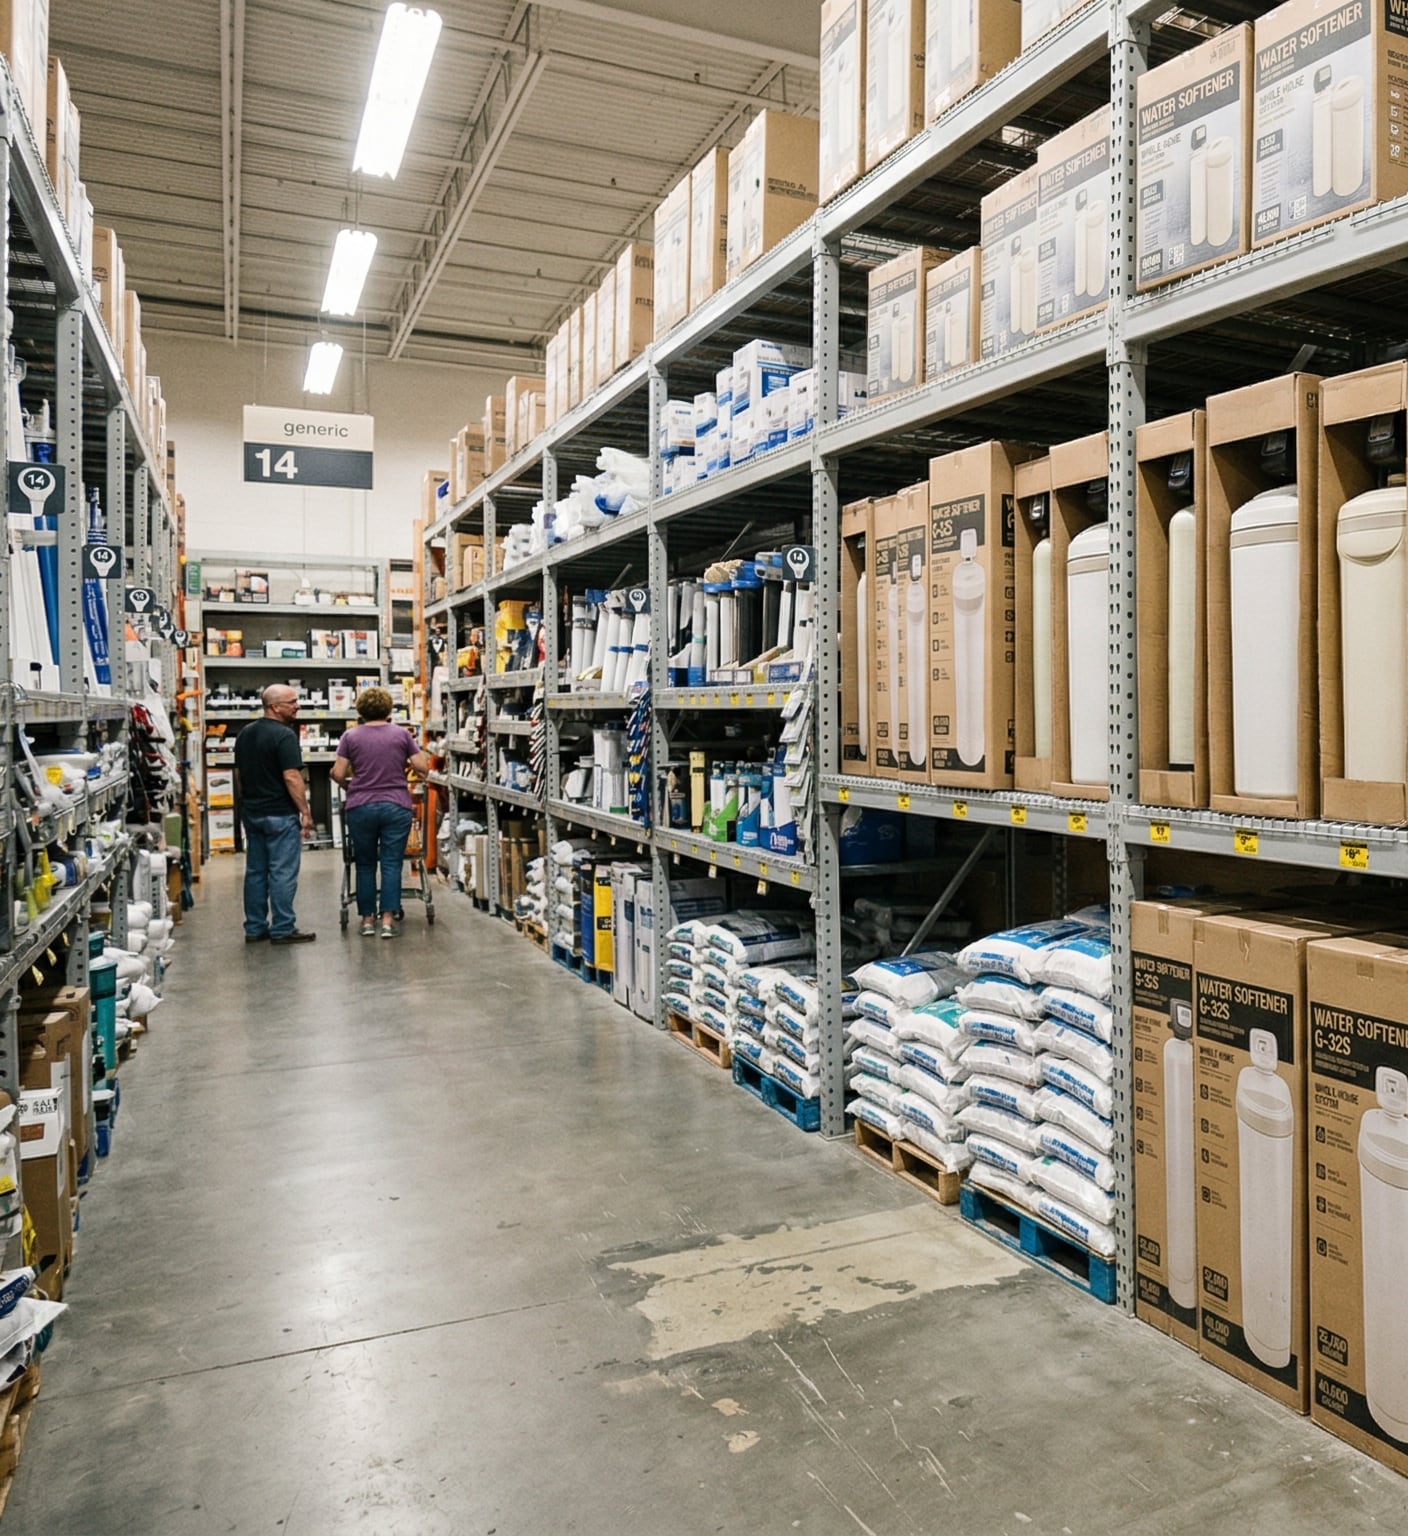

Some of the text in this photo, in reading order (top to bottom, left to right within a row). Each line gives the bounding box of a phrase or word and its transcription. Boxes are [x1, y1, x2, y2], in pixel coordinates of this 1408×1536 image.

[1259, 36, 1297, 71] WATER
[1299, 3, 1363, 49] SOFTENER
[1142, 69, 1234, 127] WATER SOFTENER
[284, 420, 349, 439] generic
[254, 448, 299, 480] 14
[27, 474, 45, 486] 14
[1198, 975, 1288, 1016] WATER SOFTENER
[1313, 1006, 1354, 1035] WATER
[1314, 1028, 1351, 1056] G-32S
